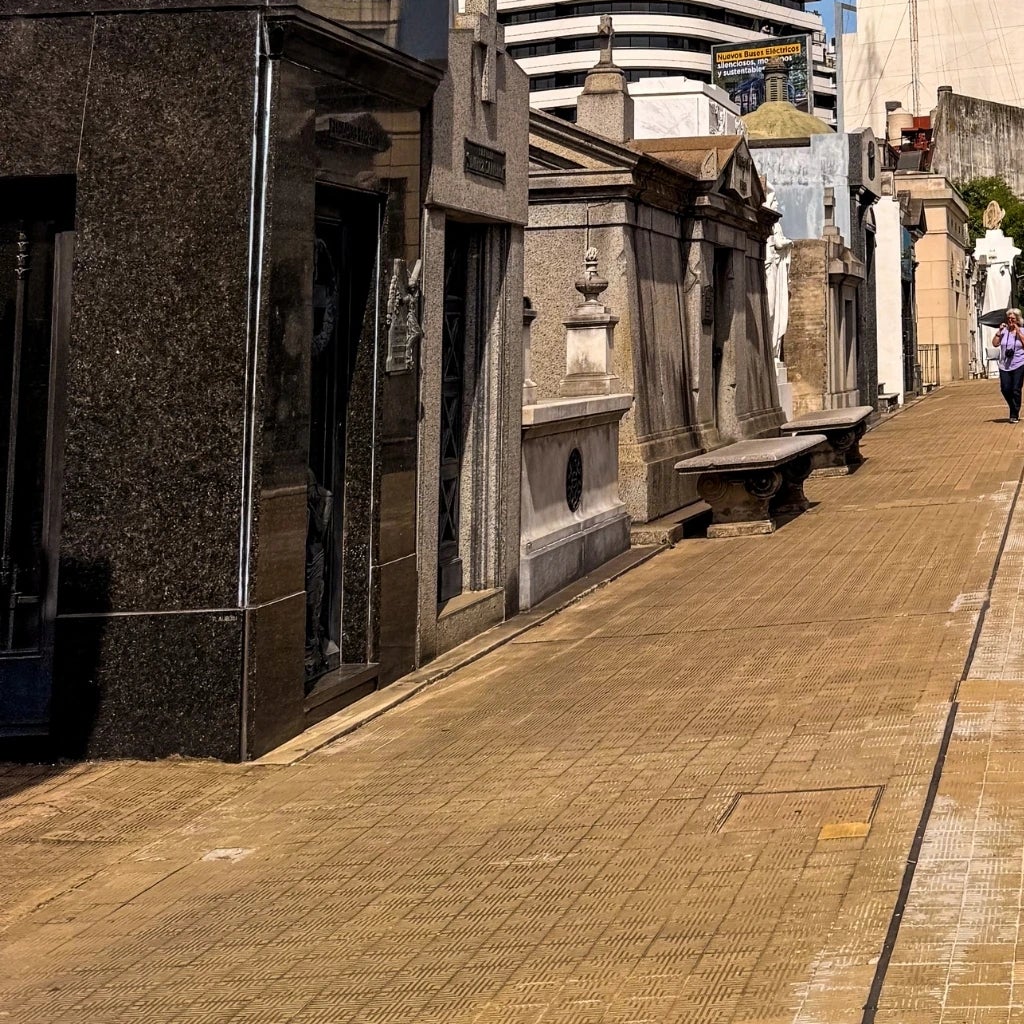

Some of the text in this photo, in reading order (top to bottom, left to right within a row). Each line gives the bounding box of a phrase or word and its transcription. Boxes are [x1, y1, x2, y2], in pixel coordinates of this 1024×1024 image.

[717, 46, 800, 61] Nuevos Buses Eléctricos
[717, 56, 793, 69] silenciosos, monos
